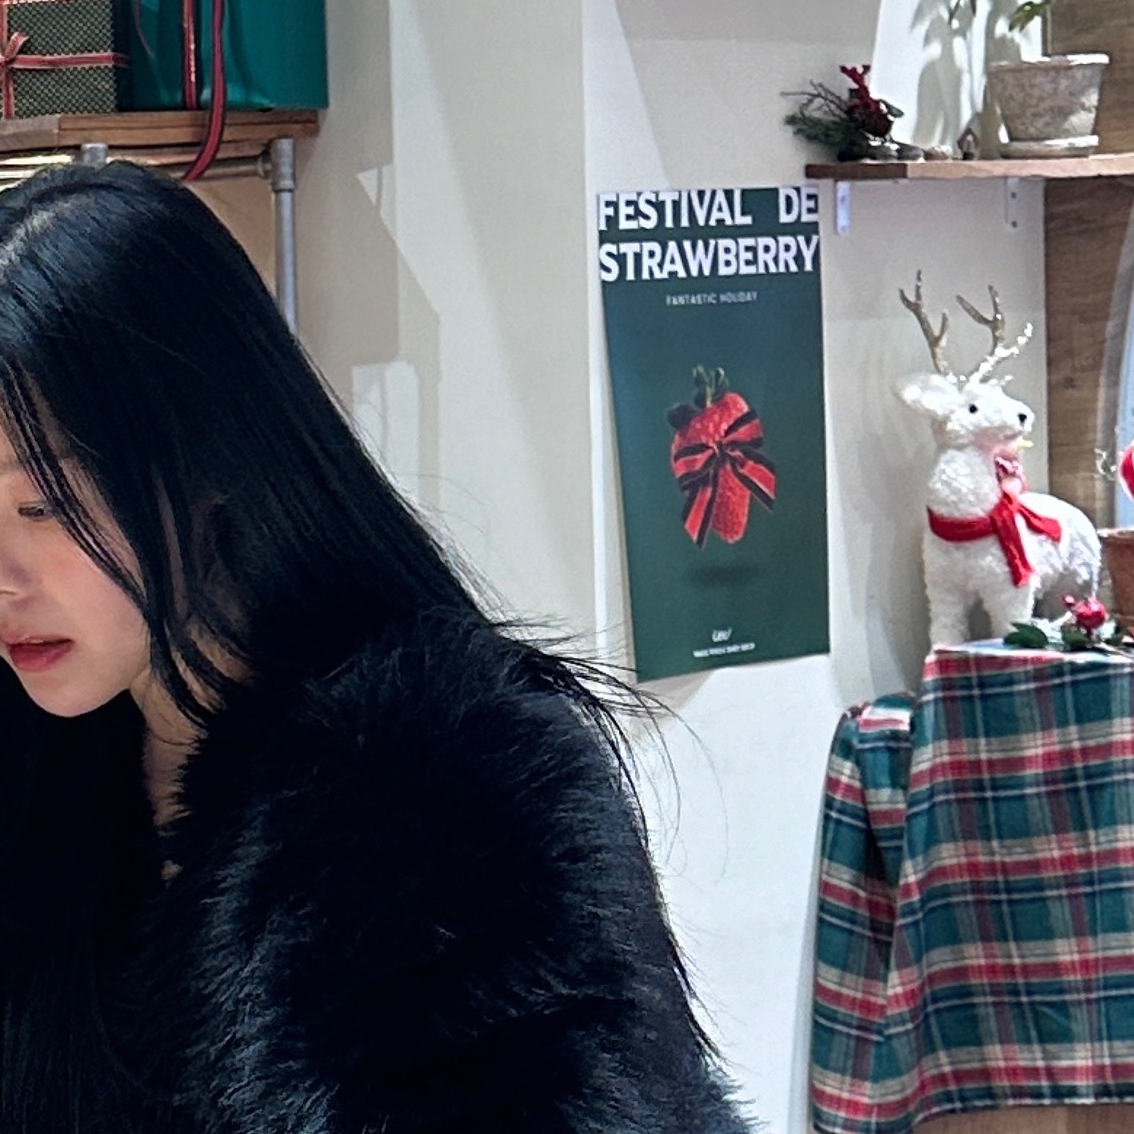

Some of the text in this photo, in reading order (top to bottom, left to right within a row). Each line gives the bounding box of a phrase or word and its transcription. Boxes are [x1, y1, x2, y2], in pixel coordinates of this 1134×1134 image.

[598, 186, 818, 231] FESTIVAL DE
[599, 234, 819, 282] STRAWBERRY
